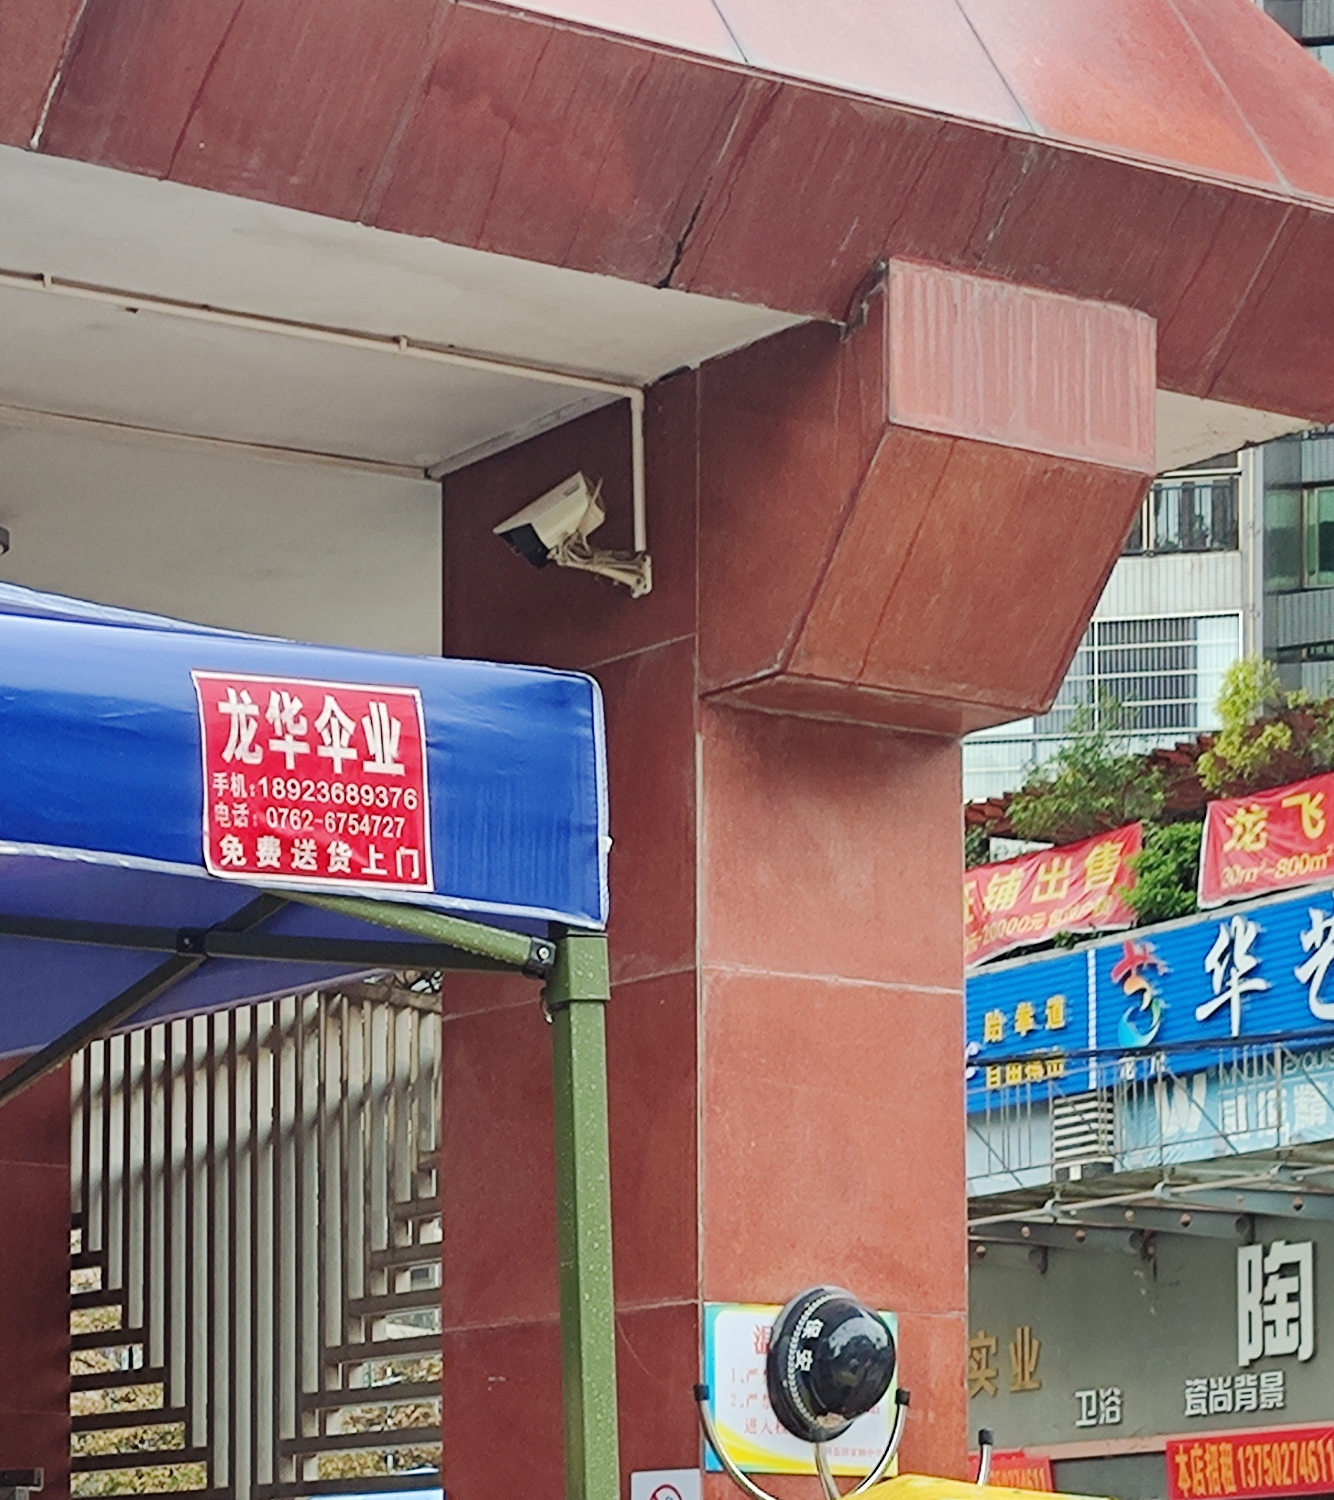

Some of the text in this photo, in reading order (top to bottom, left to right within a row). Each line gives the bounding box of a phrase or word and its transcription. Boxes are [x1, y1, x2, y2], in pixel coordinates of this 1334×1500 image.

[218, 686, 406, 776] 龙华伞业
[213, 771, 418, 811] 手机:18923689376
[219, 833, 421, 880] 免费送货上门
[968, 1325, 1042, 1398] 实业
[1074, 1388, 1123, 1428] 卫浴
[1183, 1370, 1286, 1418] 瓷尚背景
